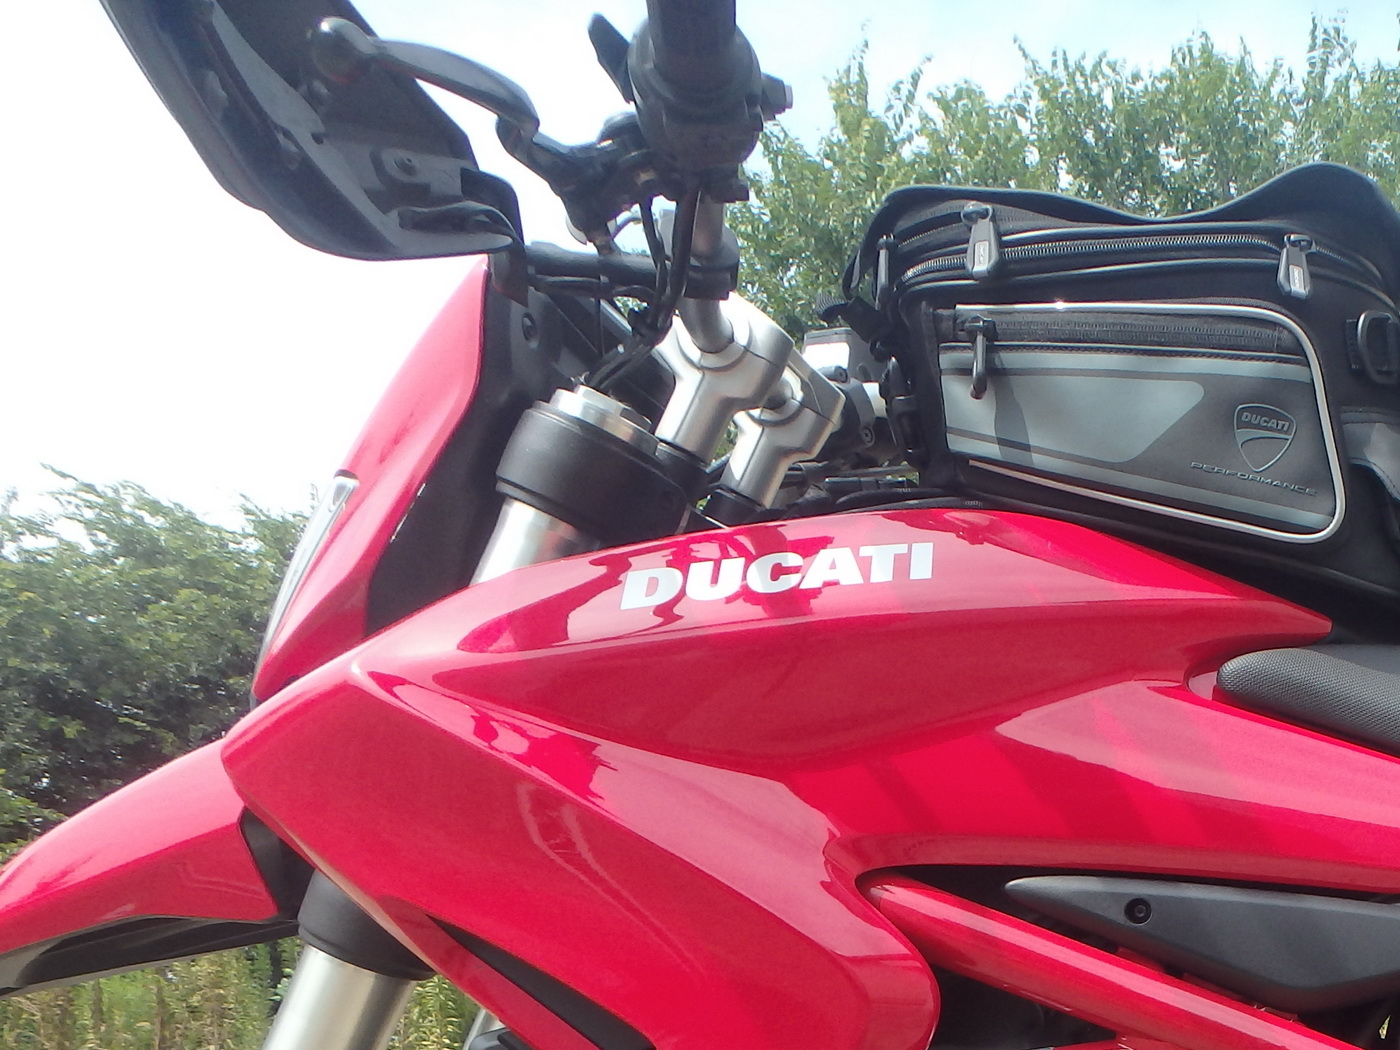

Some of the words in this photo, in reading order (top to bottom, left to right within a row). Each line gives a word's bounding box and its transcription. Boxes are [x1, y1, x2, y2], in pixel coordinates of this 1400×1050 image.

[1241, 412, 1290, 431] DUCATI
[1190, 461, 1318, 497] PERFORMANCE
[620, 542, 934, 610] DUCATI
